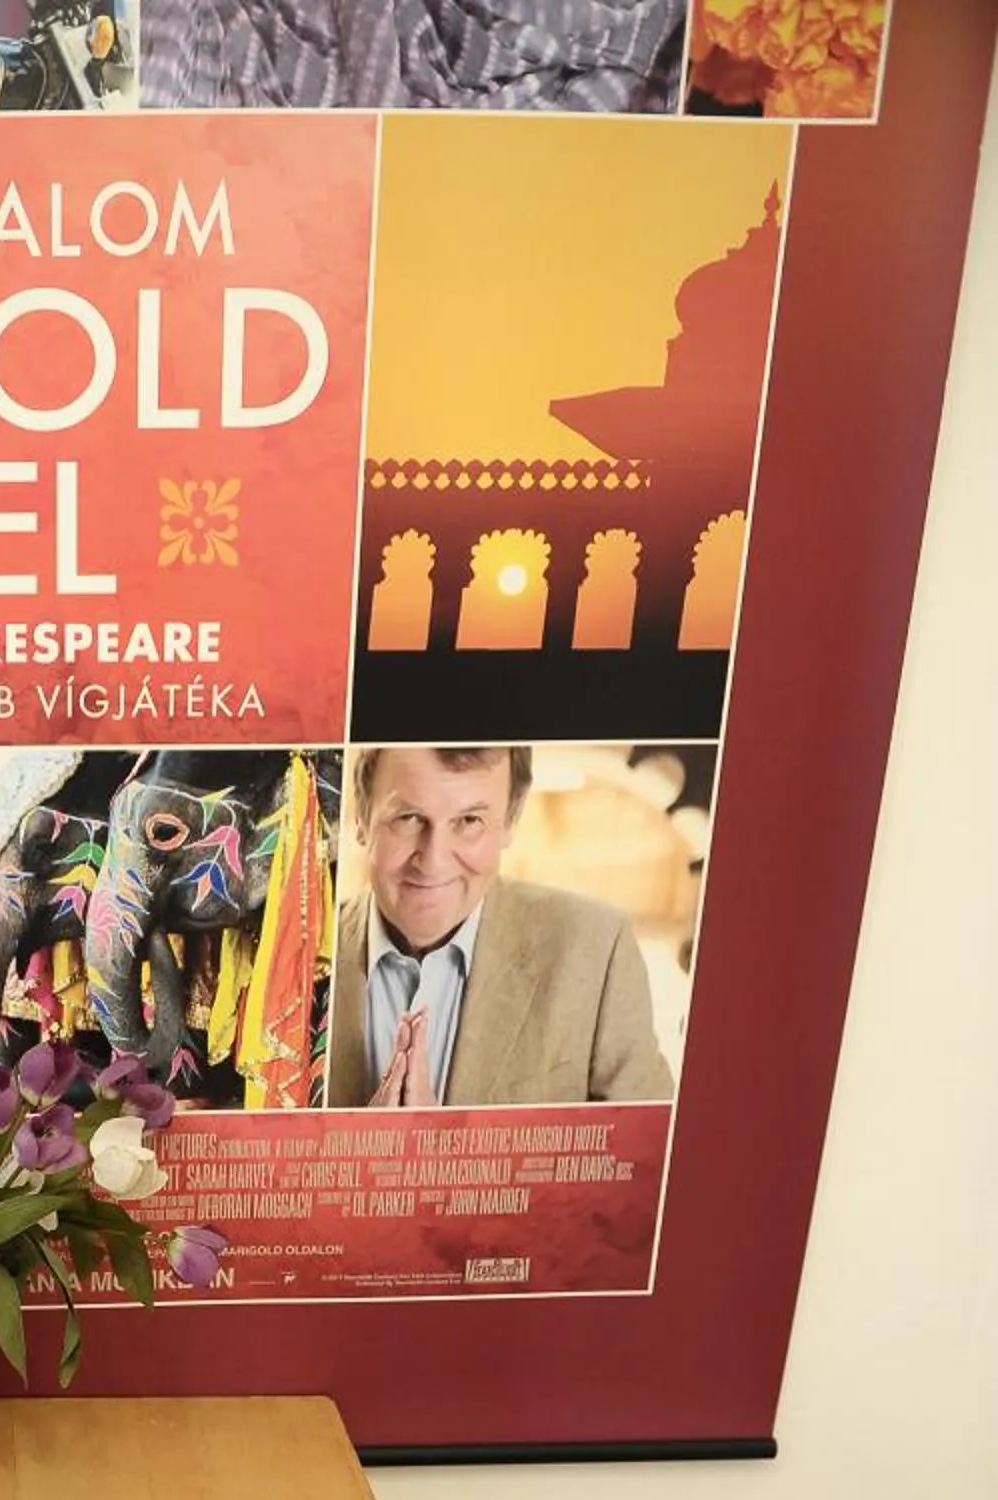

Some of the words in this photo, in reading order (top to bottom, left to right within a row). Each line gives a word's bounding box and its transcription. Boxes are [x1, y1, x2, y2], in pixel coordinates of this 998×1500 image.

[36, 677, 265, 720] VÍGJÁTÉKA
[162, 1133, 218, 1160] PICTURES
[186, 1163, 228, 1191] SARAH
[229, 1162, 276, 1190] HARVEY
[301, 1161, 337, 1188] CHRIS
[338, 1161, 362, 1188] GILL
[196, 1192, 252, 1220] DEBORAH
[368, 1189, 415, 1218] PARKER
[285, 1244, 344, 1256] OLDALON
